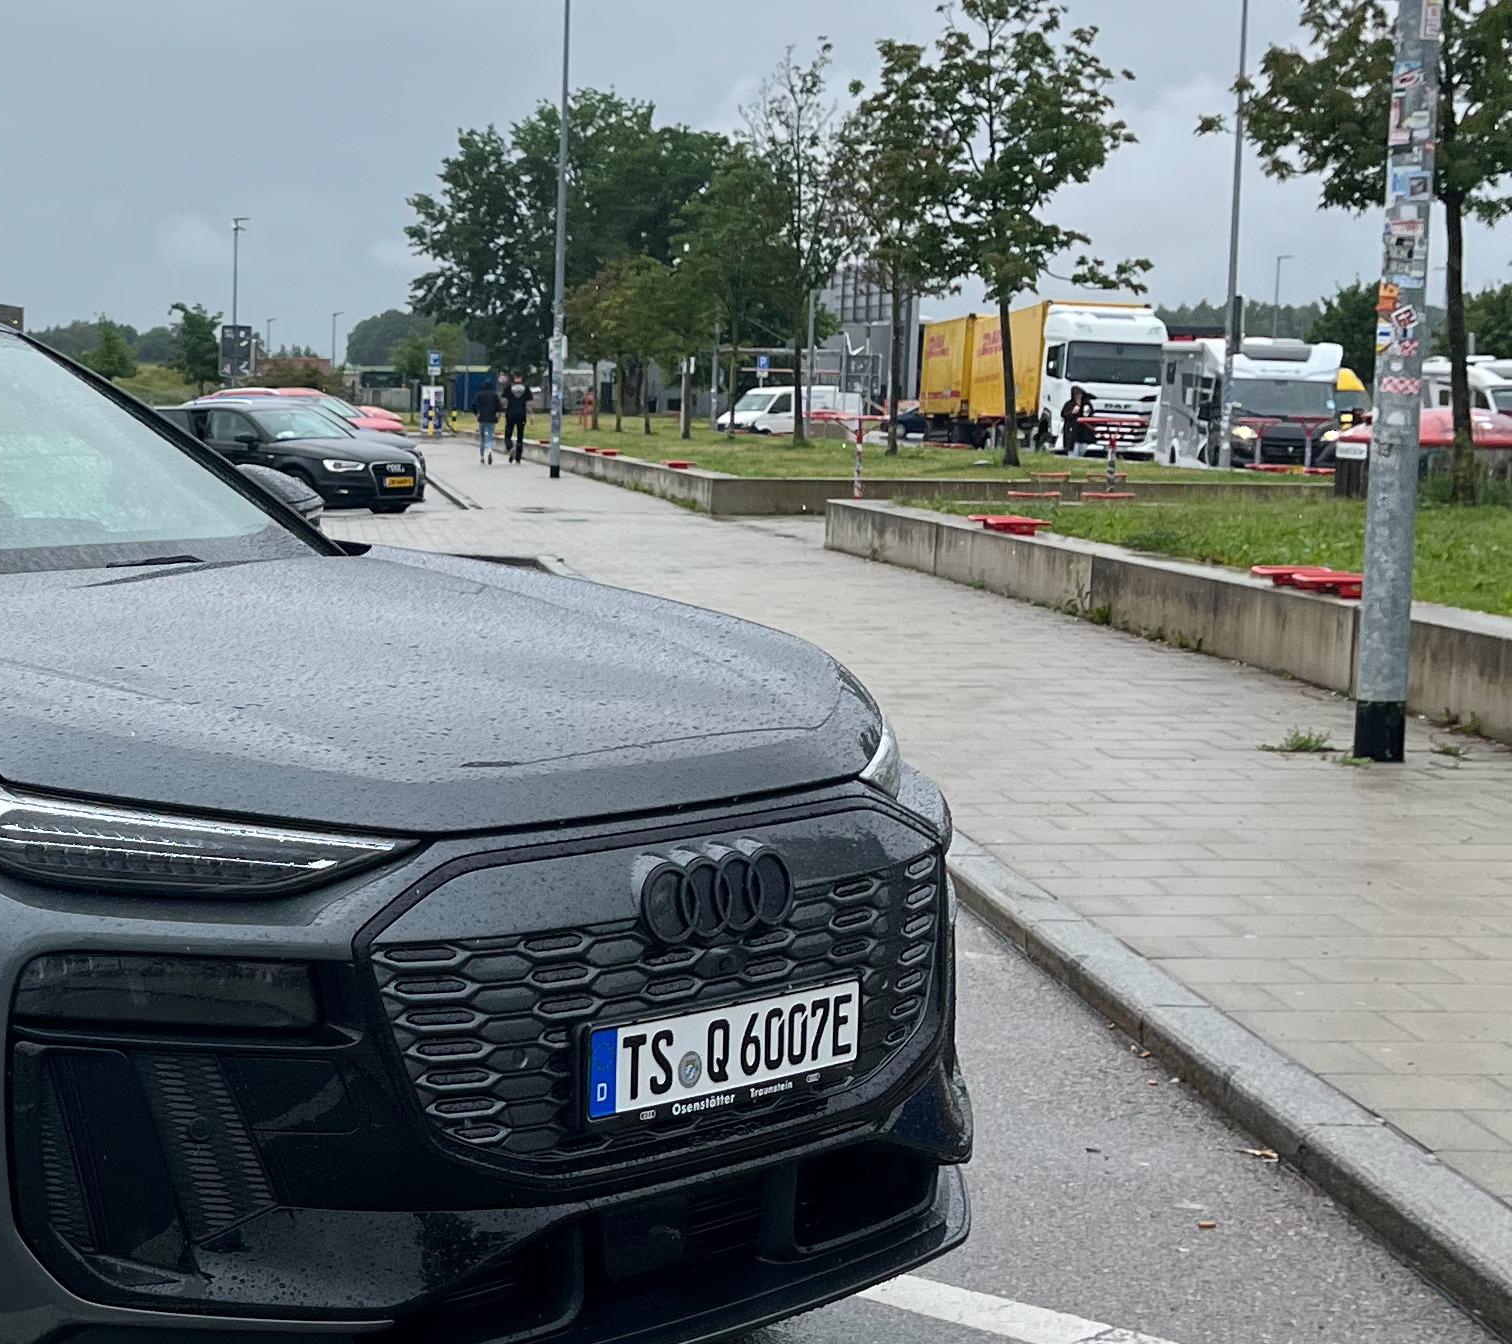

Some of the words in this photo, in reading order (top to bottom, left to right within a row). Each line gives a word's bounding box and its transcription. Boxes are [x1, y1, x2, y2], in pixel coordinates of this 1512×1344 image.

[622, 1029, 674, 1100] TS
[707, 1019, 730, 1083] Q
[740, 993, 853, 1076] 6007E
[596, 1082, 608, 1102] D
[672, 1093, 736, 1116] Osenstätter
[749, 1081, 793, 1098] Traunstein
